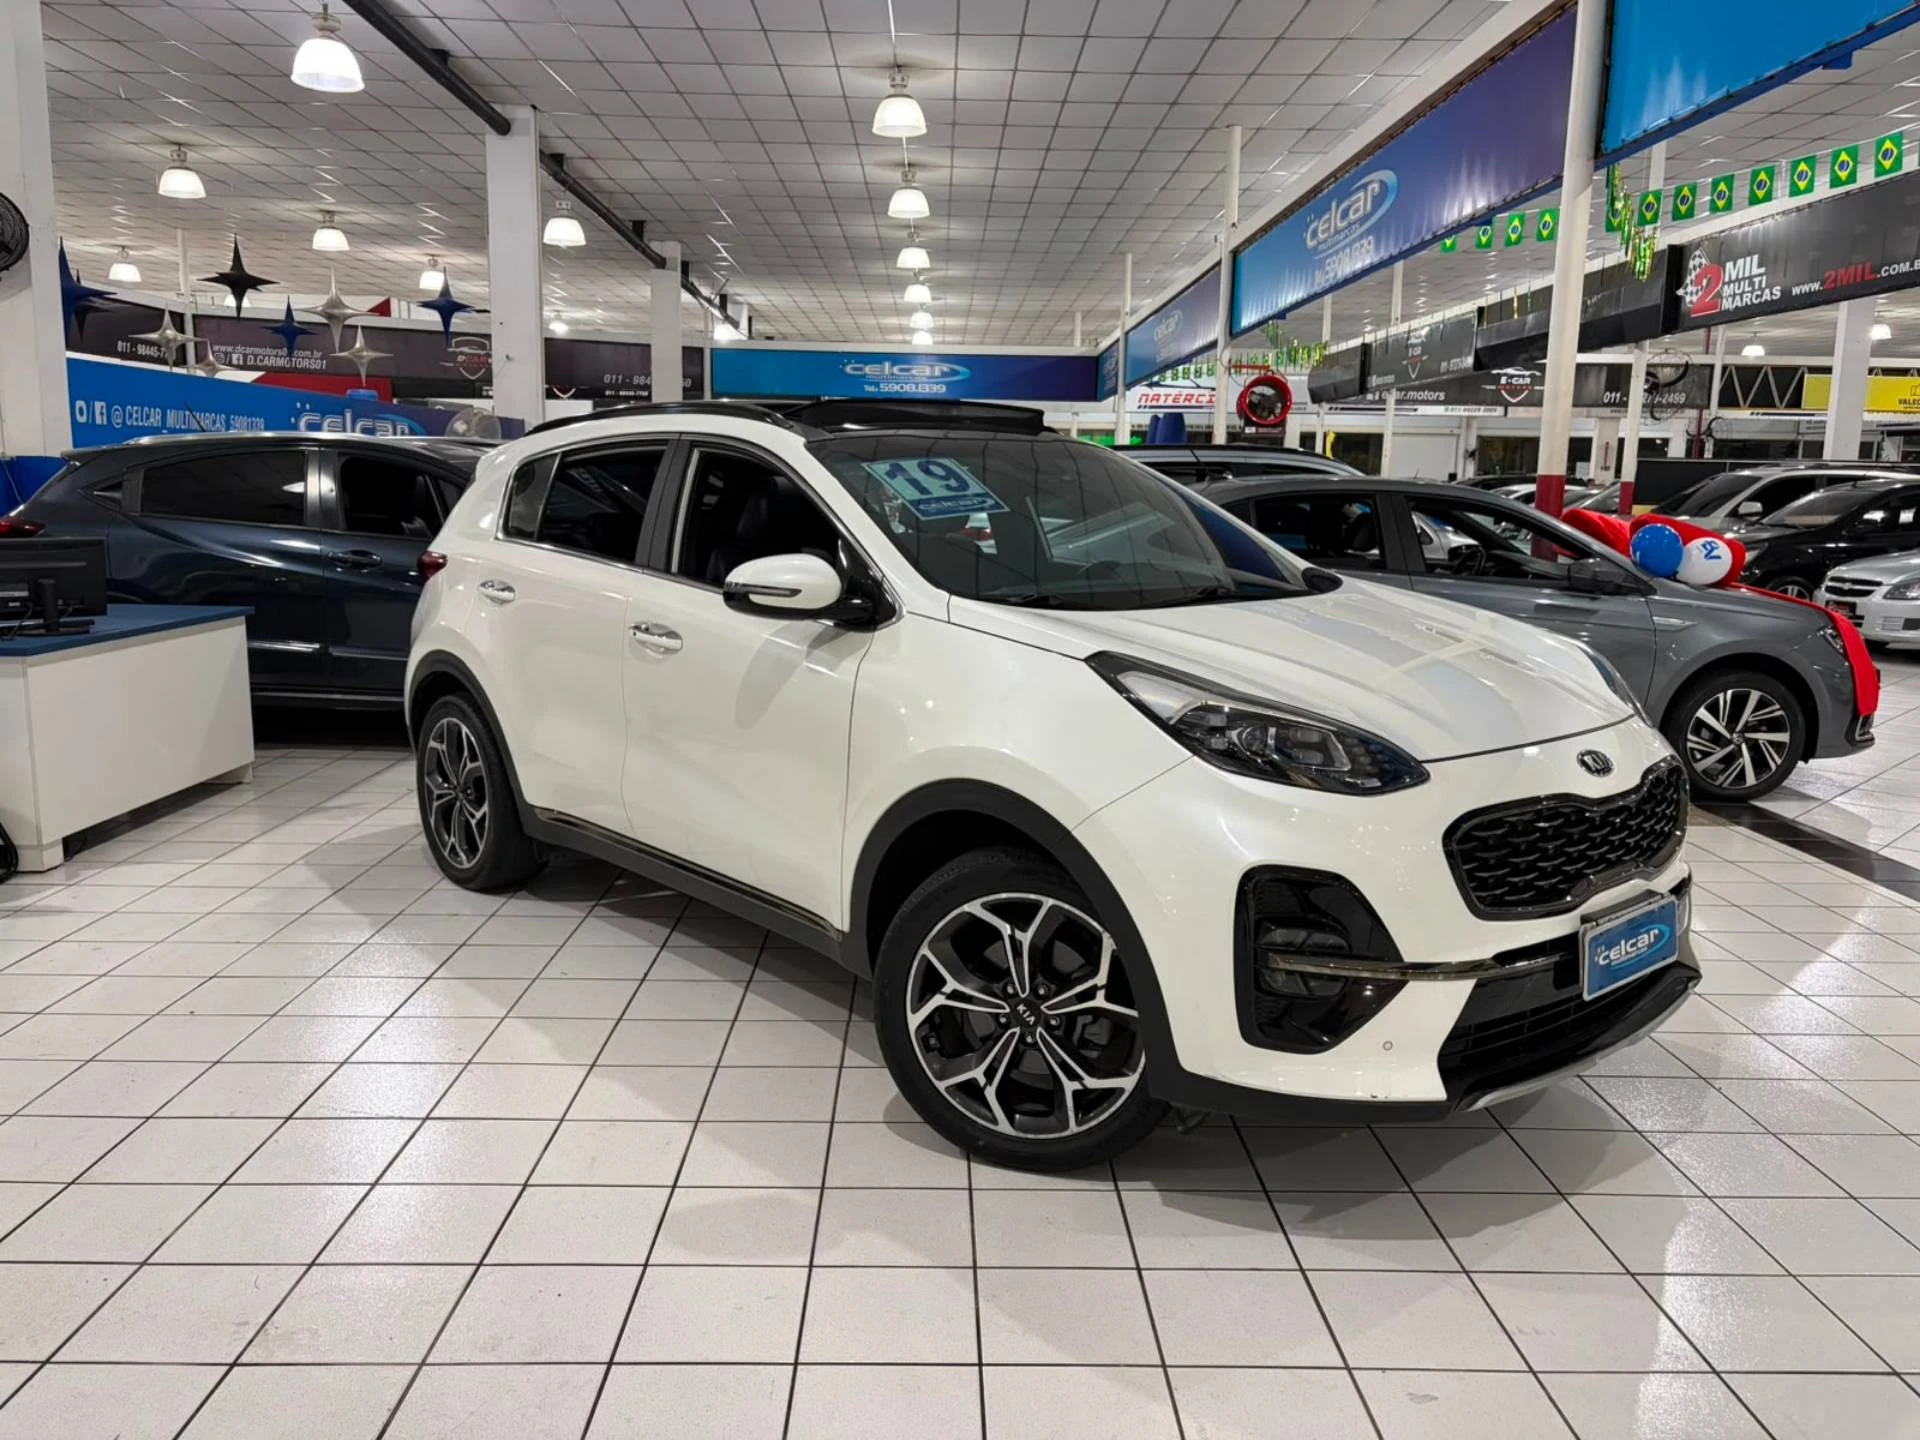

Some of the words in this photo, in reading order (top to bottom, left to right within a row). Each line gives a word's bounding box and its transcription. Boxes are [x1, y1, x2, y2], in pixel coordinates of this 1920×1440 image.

[1306, 182, 1379, 248] celcar
[1724, 254, 1766, 282] MIL
[1691, 264, 1724, 318] 2
[1721, 286, 1781, 312] MARCAS
[1723, 277, 1767, 298] MULTI
[116, 340, 131, 353] 011
[213, 344, 322, 359] www.dcarmotors0.com.br
[604, 374, 622, 384] 011
[844, 360, 951, 377] celcar
[1603, 391, 1621, 404] 011
[884, 460, 970, 496] 19
[1598, 928, 1660, 966] celcar
[1016, 1003, 1036, 1026] KIA
